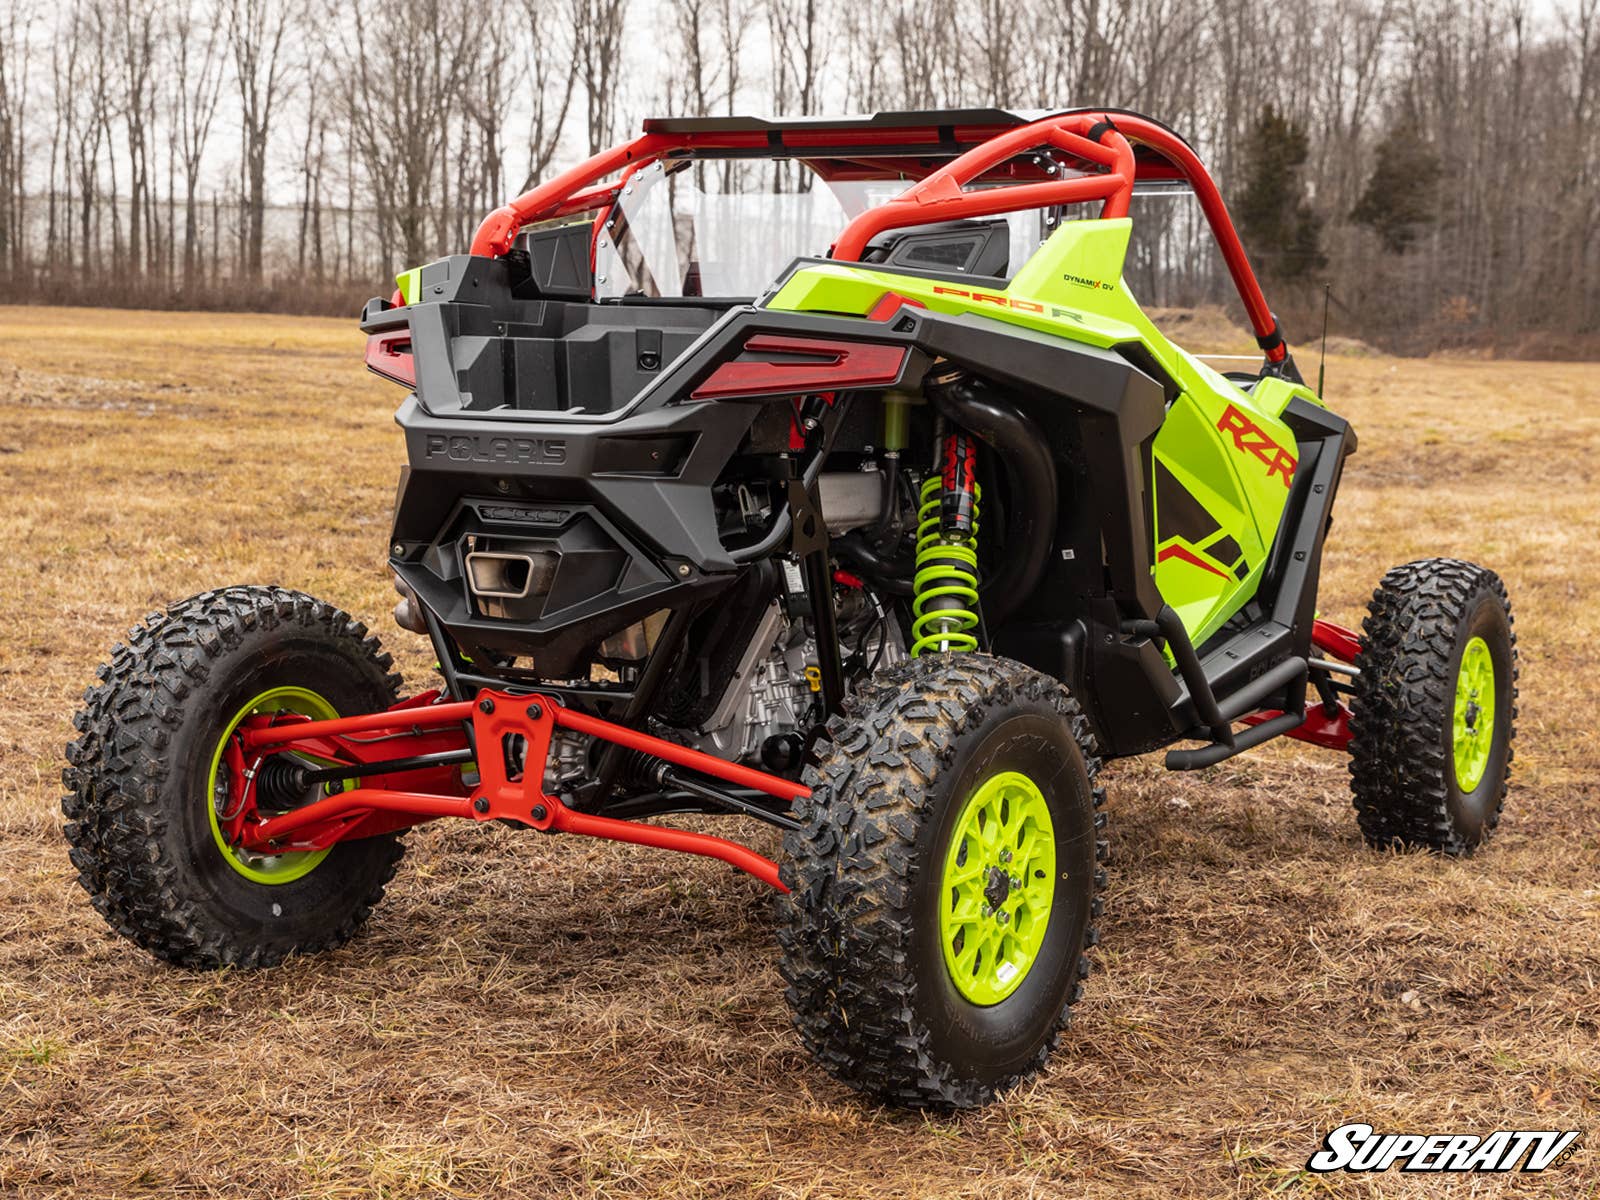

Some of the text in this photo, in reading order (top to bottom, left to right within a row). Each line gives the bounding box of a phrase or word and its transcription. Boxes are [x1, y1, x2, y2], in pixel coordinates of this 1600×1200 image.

[1063, 273, 1115, 291] DYNAMIX DV
[933, 286, 1084, 325] PRO R
[425, 434, 567, 466] POLARIS
[1216, 403, 1298, 490] RZR
